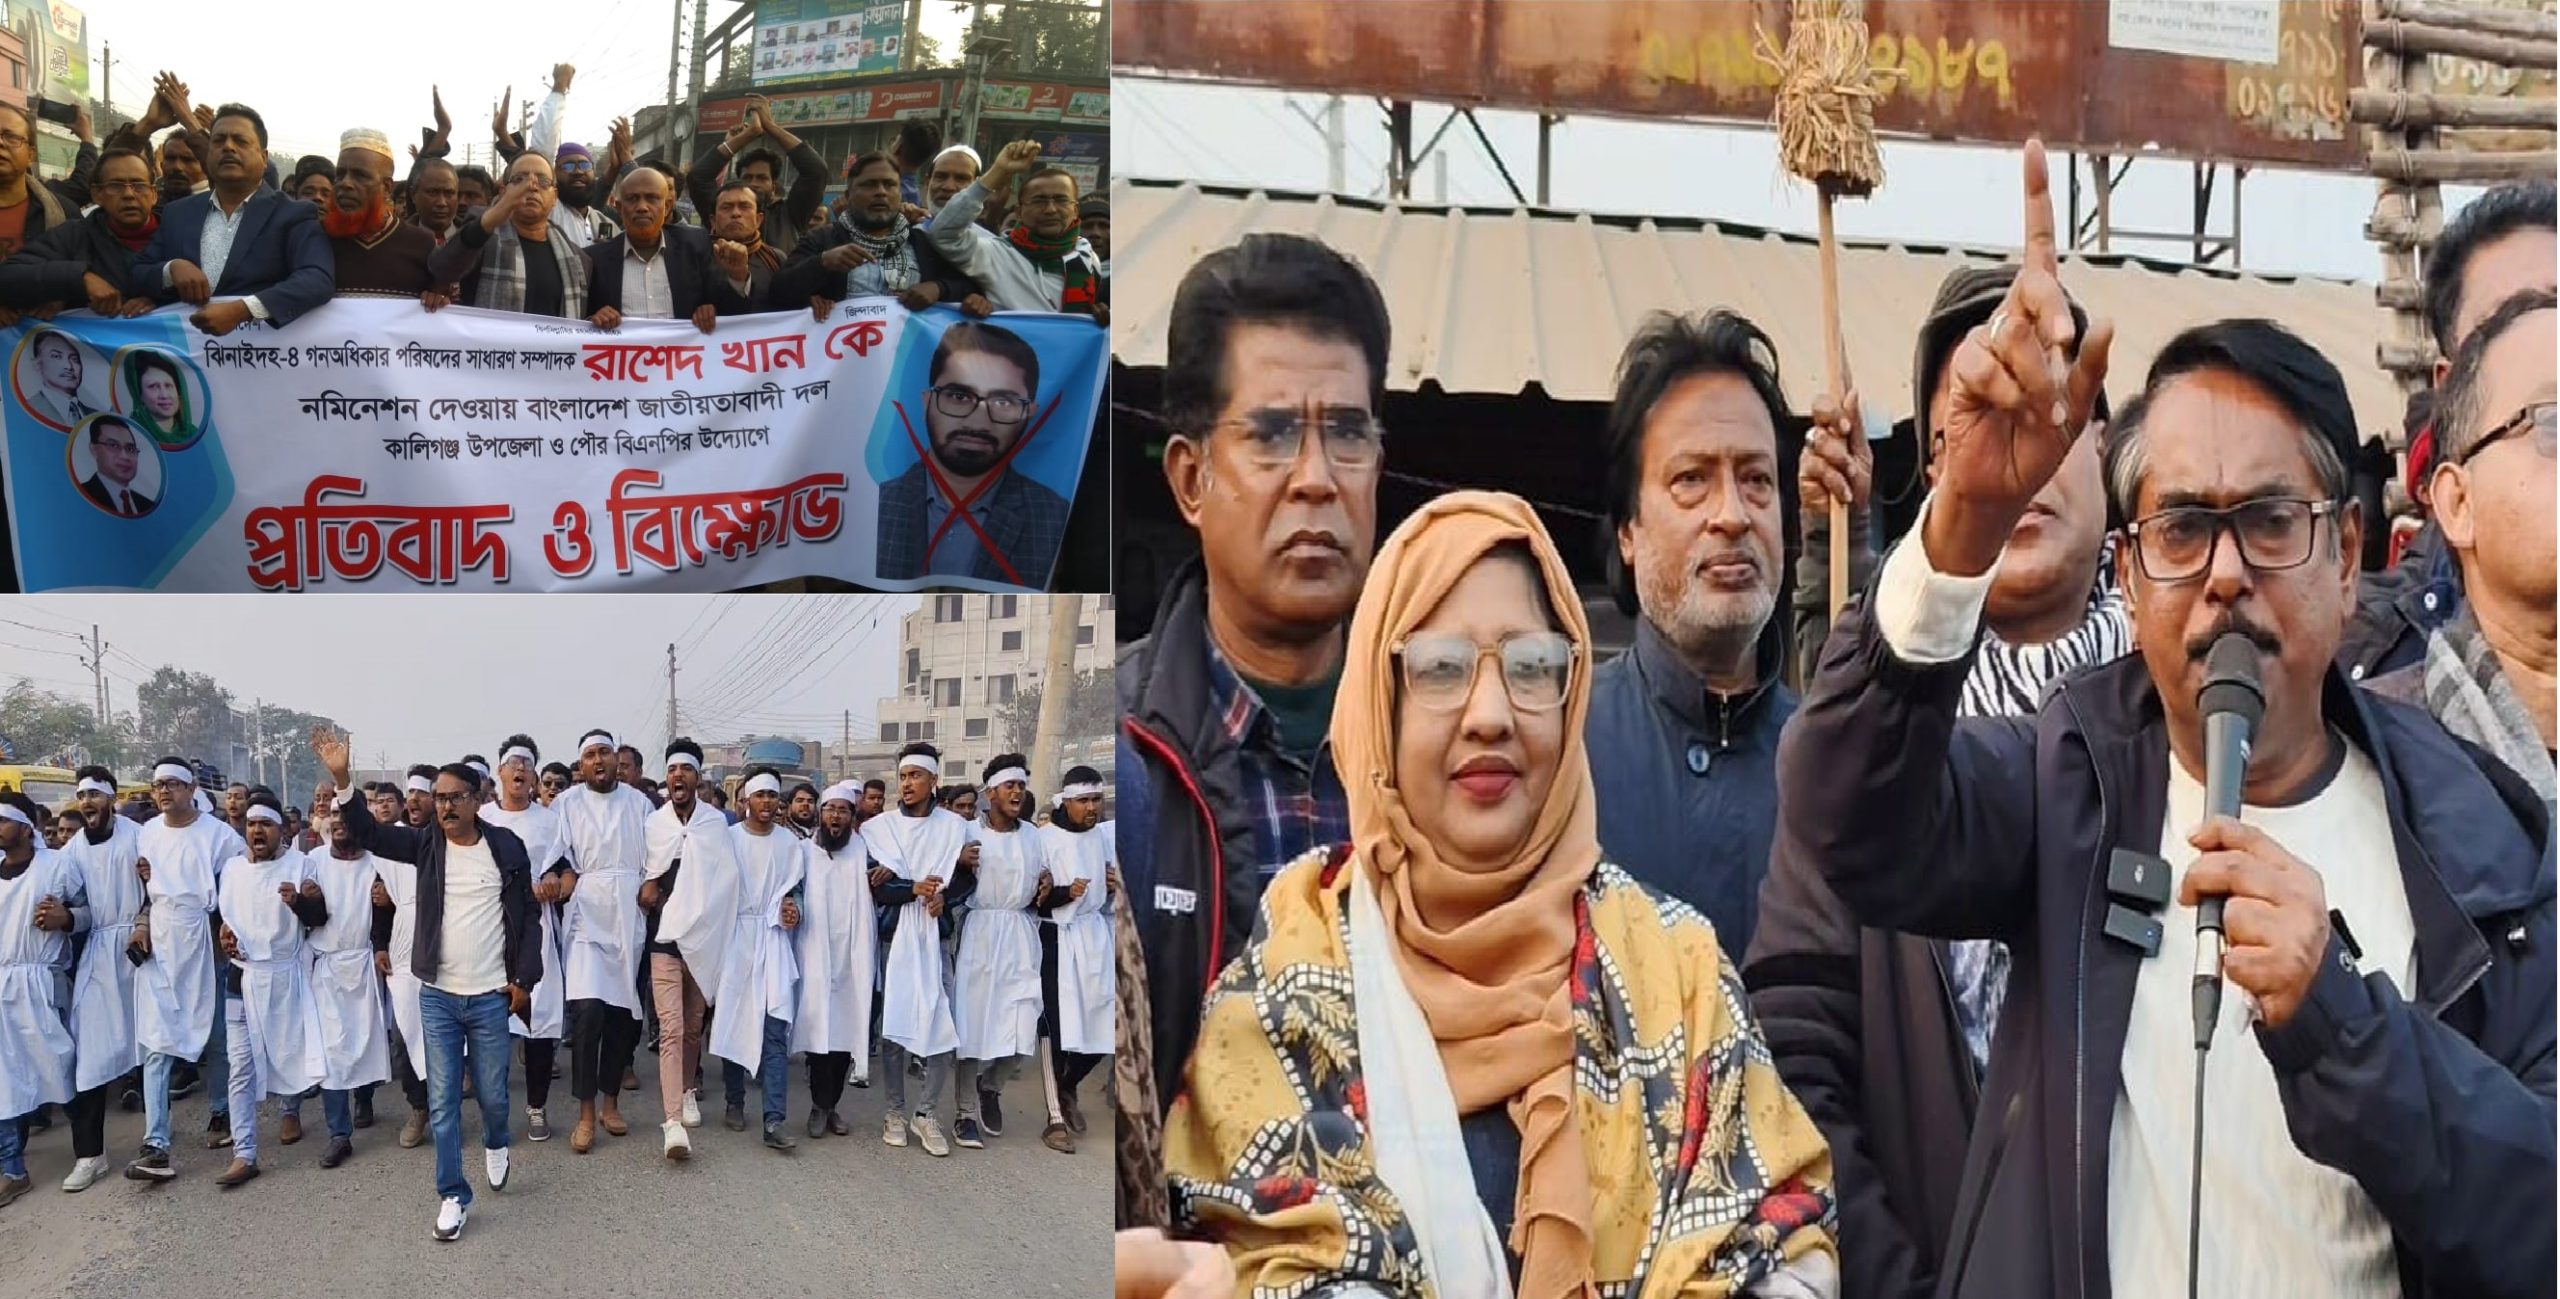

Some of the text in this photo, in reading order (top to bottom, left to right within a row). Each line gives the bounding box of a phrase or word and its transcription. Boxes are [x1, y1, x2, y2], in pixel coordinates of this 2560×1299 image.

[845, 304, 887, 319] জিন্দাবাদ
[204, 320, 887, 383] ঝিনাইদহ-৪ গনঅধিকার পরিষদের সাধারণ সম্পাদক রাশেদ খান কে
[298, 380, 831, 421] নমিনেশন দেওয়ায় বাংলাদেশ জাতীয়তাবাদী দল
[383, 424, 771, 460] কালিগঞ্জ উপজেলা ও পৌর বিএনপির উদ্যোগে
[243, 467, 850, 592] প্রতিবাদ ও বিক্ষোভ
